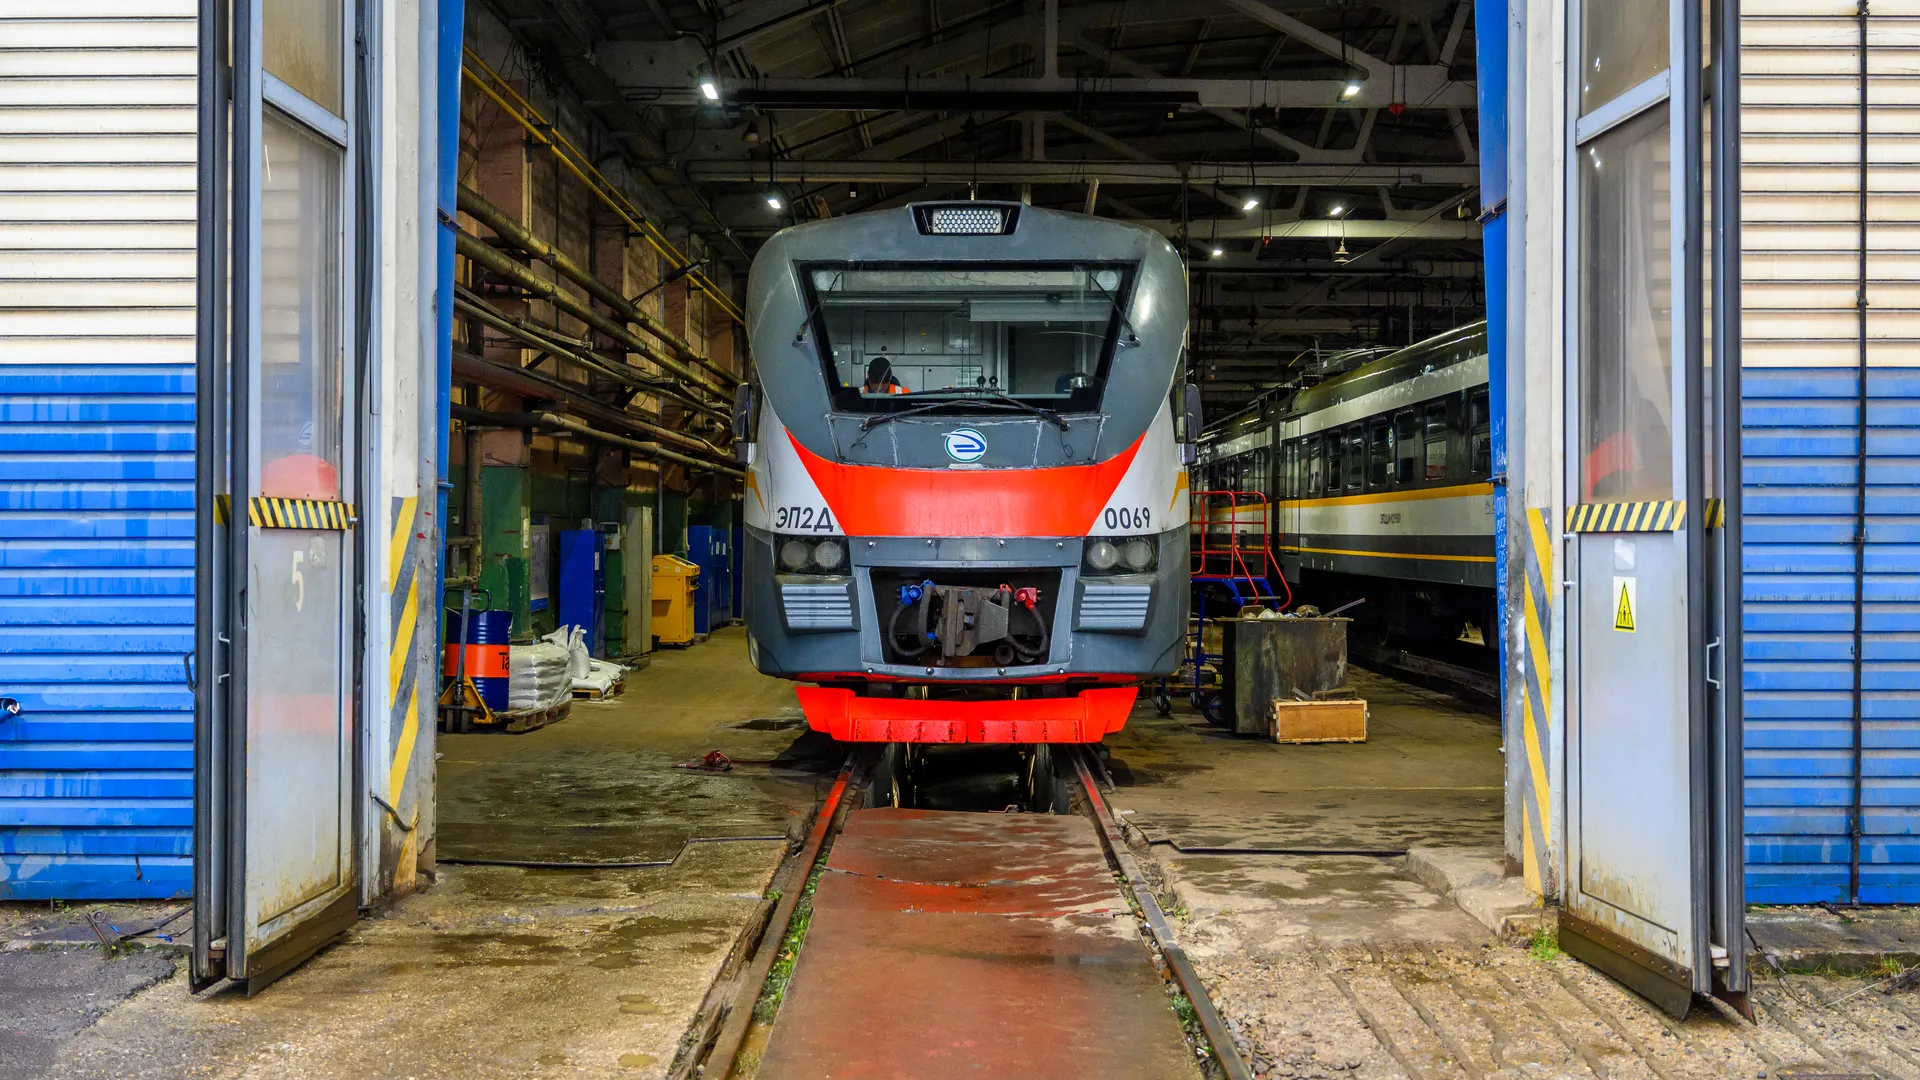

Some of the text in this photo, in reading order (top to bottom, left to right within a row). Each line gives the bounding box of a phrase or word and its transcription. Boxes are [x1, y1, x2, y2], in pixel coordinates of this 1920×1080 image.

[775, 506, 834, 533] ЭП2Д
[1104, 506, 1151, 530] 0069
[291, 550, 304, 613] 5
